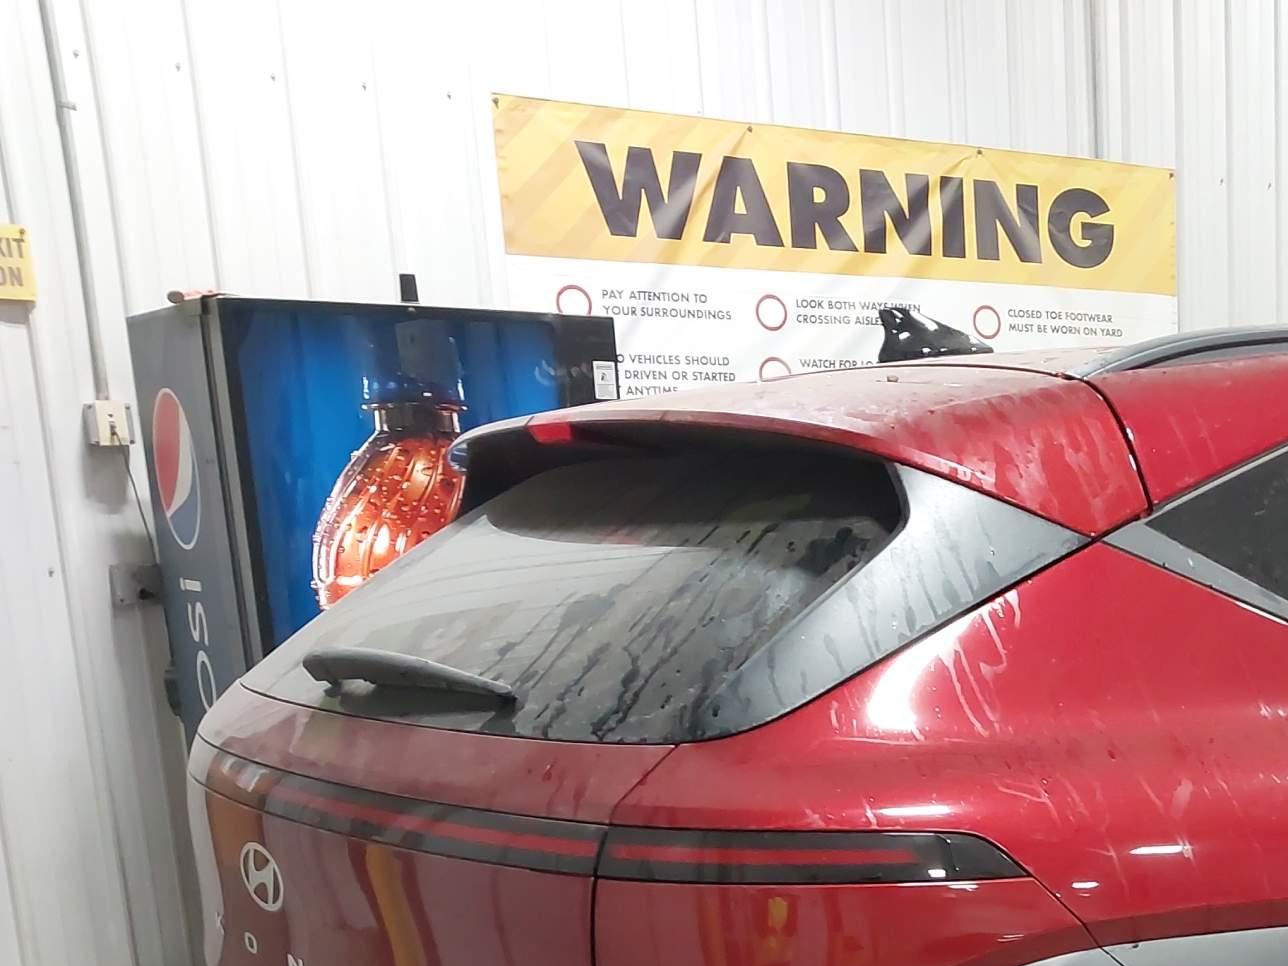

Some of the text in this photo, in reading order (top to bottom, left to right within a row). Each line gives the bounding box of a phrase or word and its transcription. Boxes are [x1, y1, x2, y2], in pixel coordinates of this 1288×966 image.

[574, 140, 1115, 269] WARNING
[602, 289, 708, 304] PAY ATTENTION TO
[796, 299, 824, 310] LOOK
[828, 300, 856, 311] BOTH
[602, 305, 732, 321] YOUR SURROUNDINGS
[796, 314, 851, 326] CROSSING
[1007, 308, 1113, 324] CLOSED TOE FOOTWEAR
[1008, 323, 1123, 338] MUST BE WORN ON YARD
[628, 353, 681, 366] VEHICLES
[685, 355, 730, 367] SHOULD
[799, 358, 836, 369] WATCH
[624, 369, 667, 380] DRIVEN
[671, 370, 688, 381] OR
[692, 371, 736, 382] STARTED
